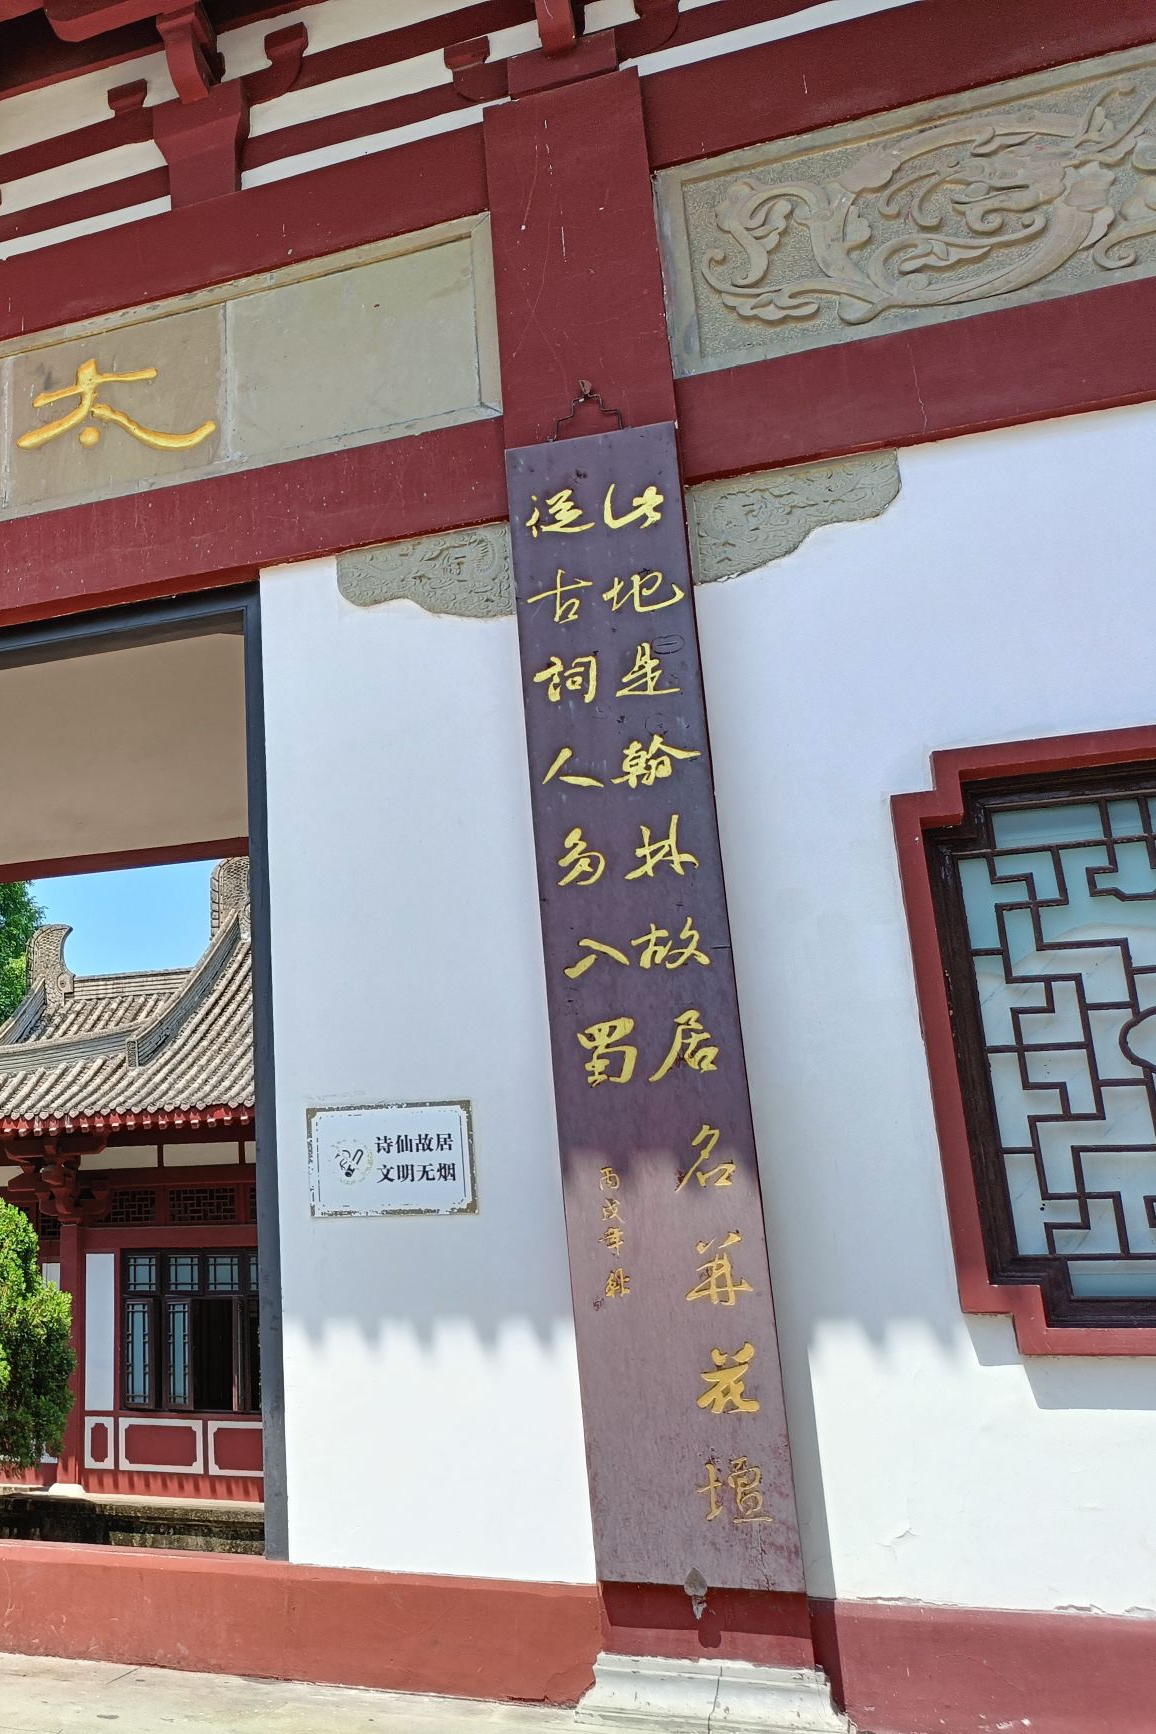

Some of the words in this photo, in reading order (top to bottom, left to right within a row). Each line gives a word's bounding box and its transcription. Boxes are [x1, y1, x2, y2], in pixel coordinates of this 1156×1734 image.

[374, 1132, 454, 1154] 诗仙故居
[376, 1162, 457, 1183] 文明无烟
